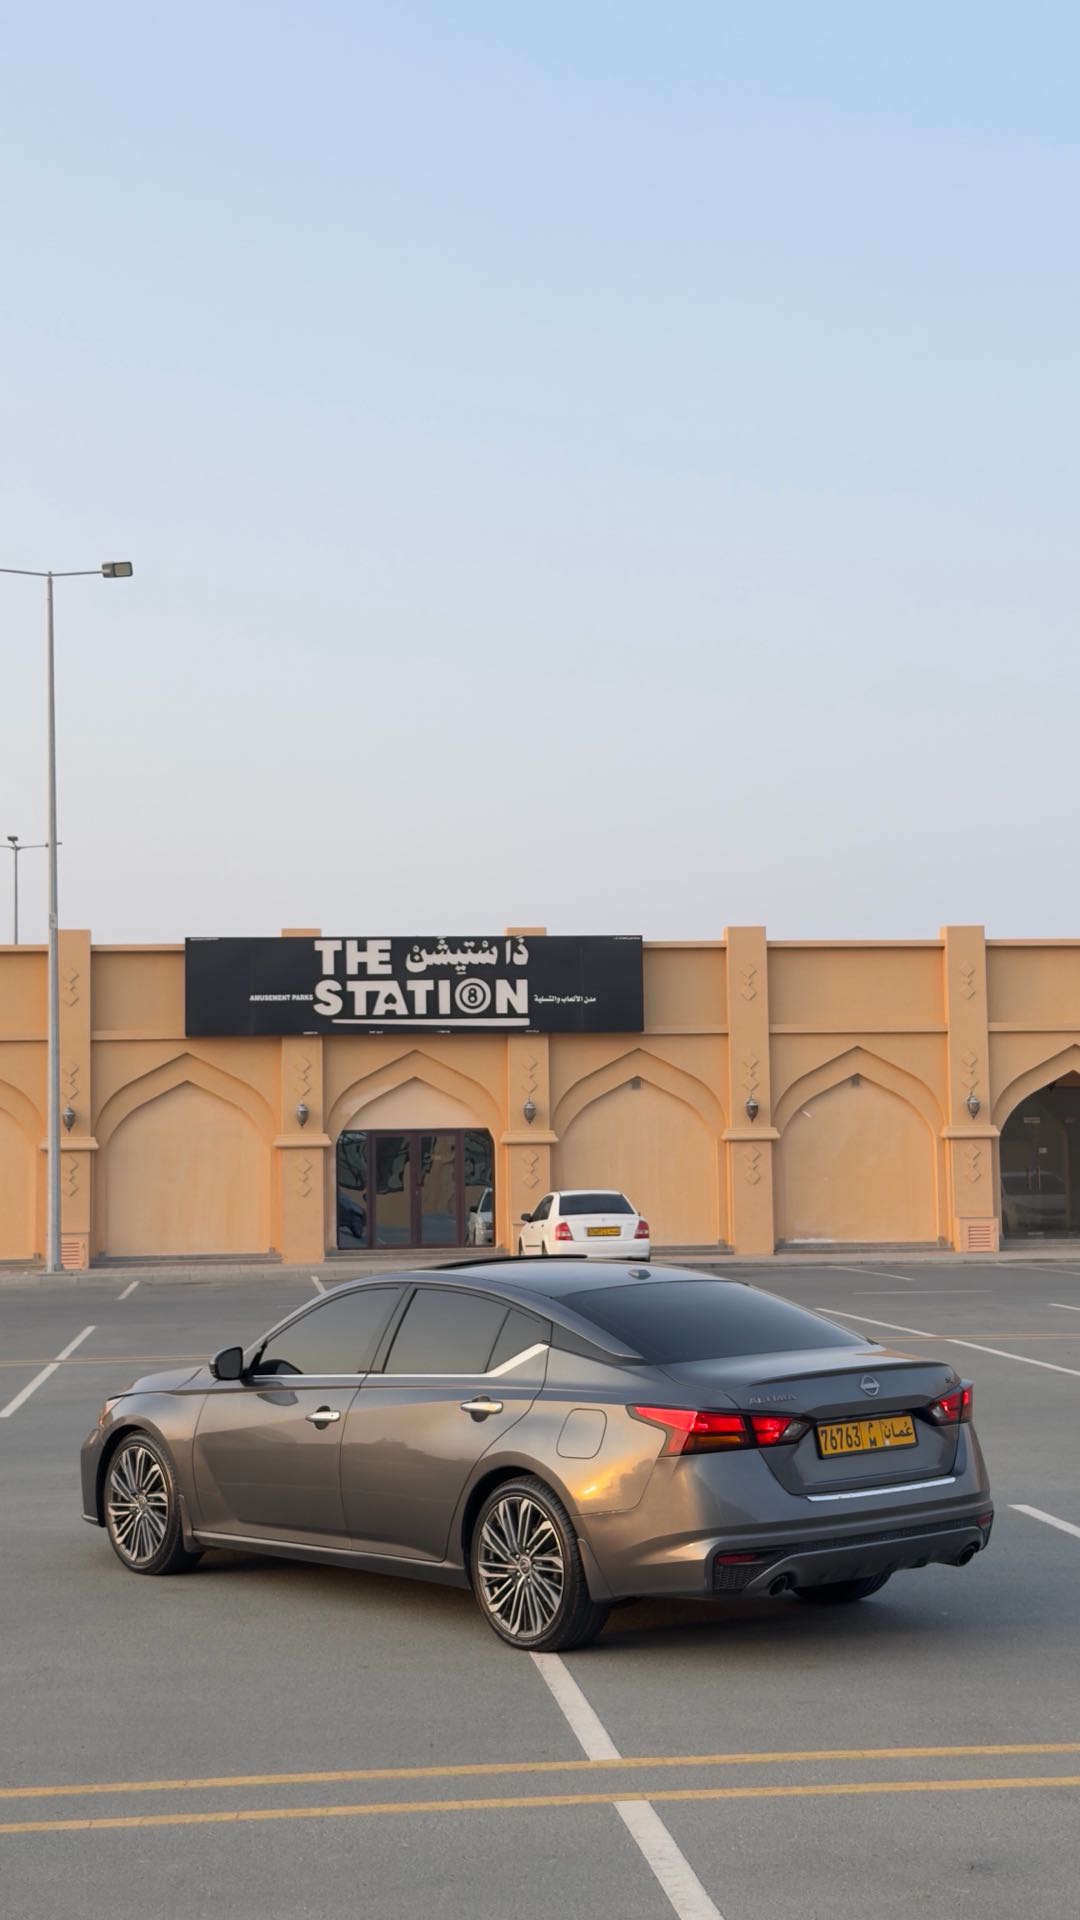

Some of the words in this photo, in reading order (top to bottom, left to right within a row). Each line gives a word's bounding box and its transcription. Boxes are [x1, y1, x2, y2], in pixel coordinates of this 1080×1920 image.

[314, 939, 392, 975] THE
[313, 978, 529, 1016] STATION
[820, 1425, 861, 1451] 76763
[869, 1437, 877, 1447] M
